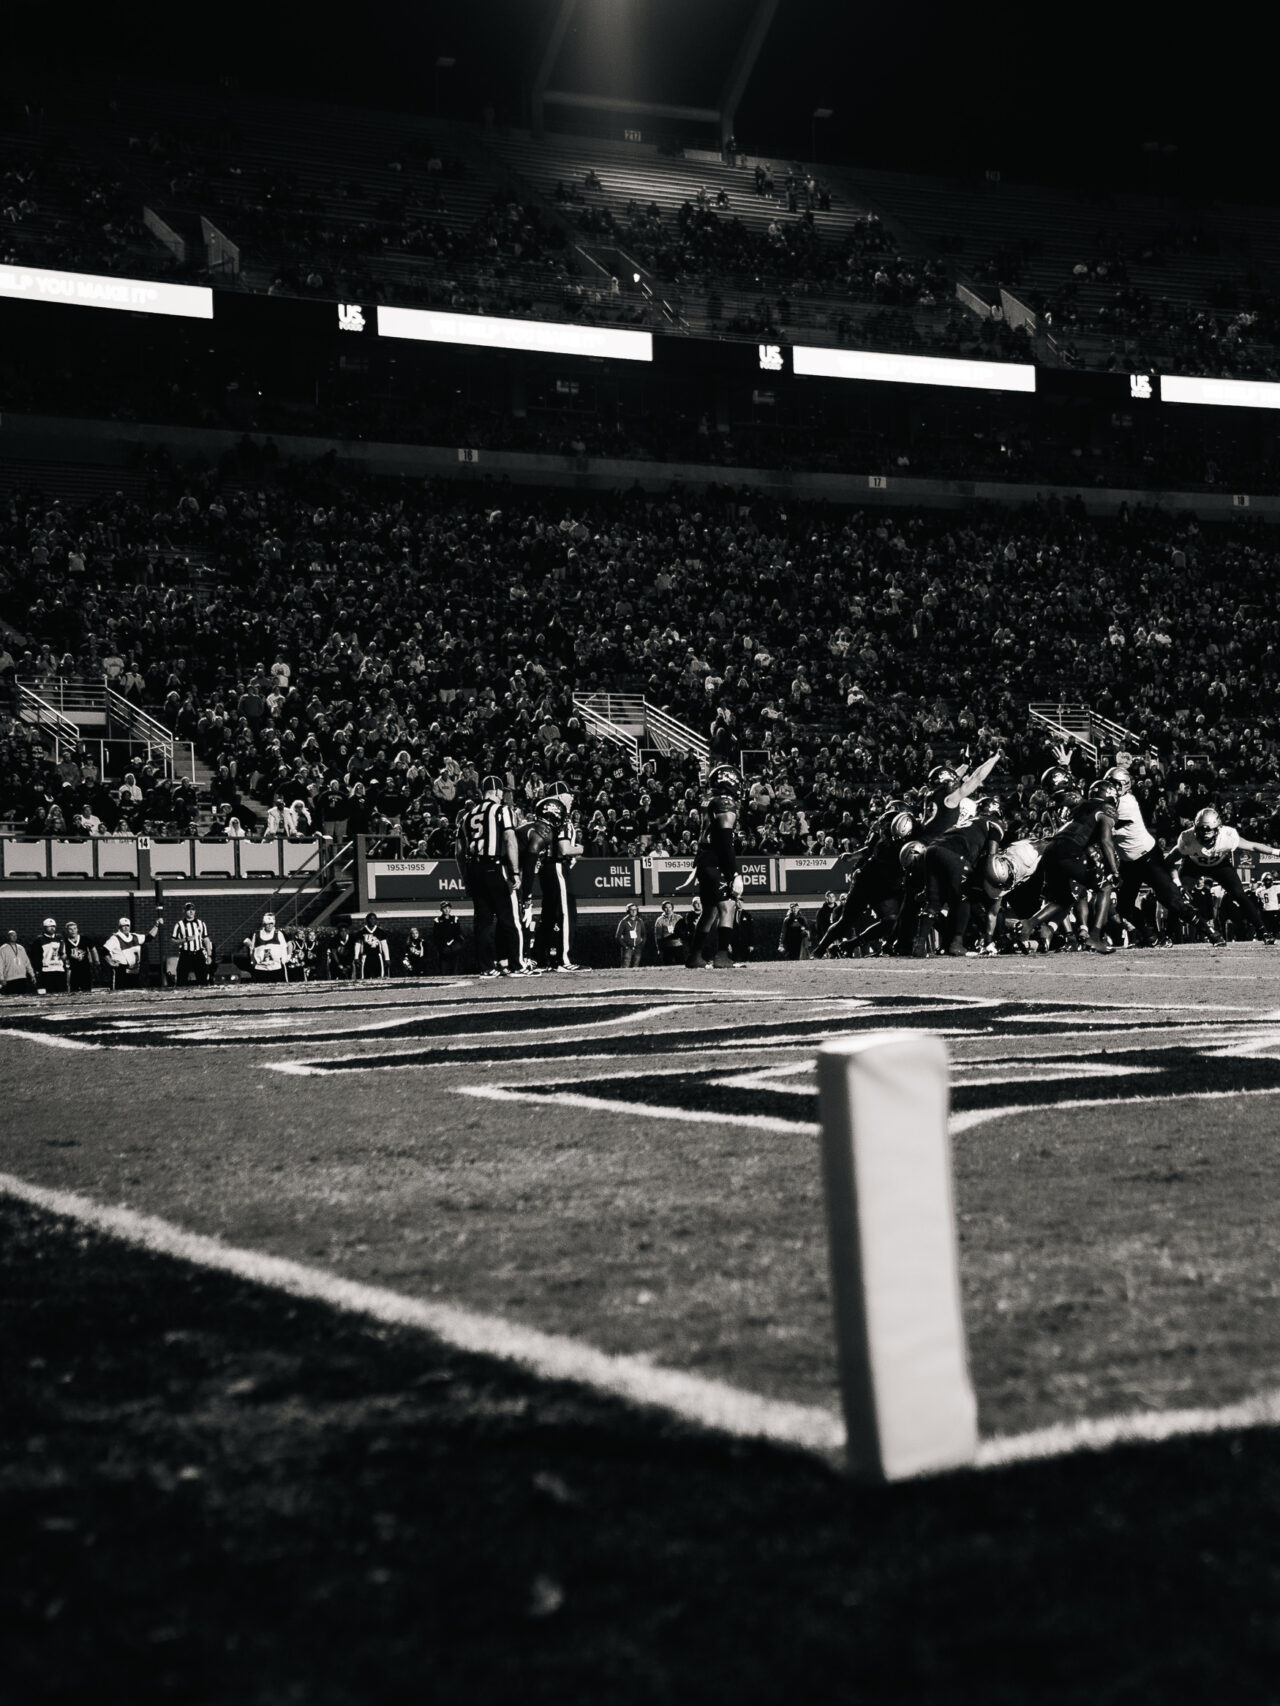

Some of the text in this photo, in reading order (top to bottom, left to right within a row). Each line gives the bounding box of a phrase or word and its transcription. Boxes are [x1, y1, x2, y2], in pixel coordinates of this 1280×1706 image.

[386, 863, 426, 871] 1953-1955
[795, 859, 828, 867] 1972-1974
[609, 866, 631, 875] BILL
[741, 864, 767, 873] DAVE
[594, 876, 632, 887] CLINE
